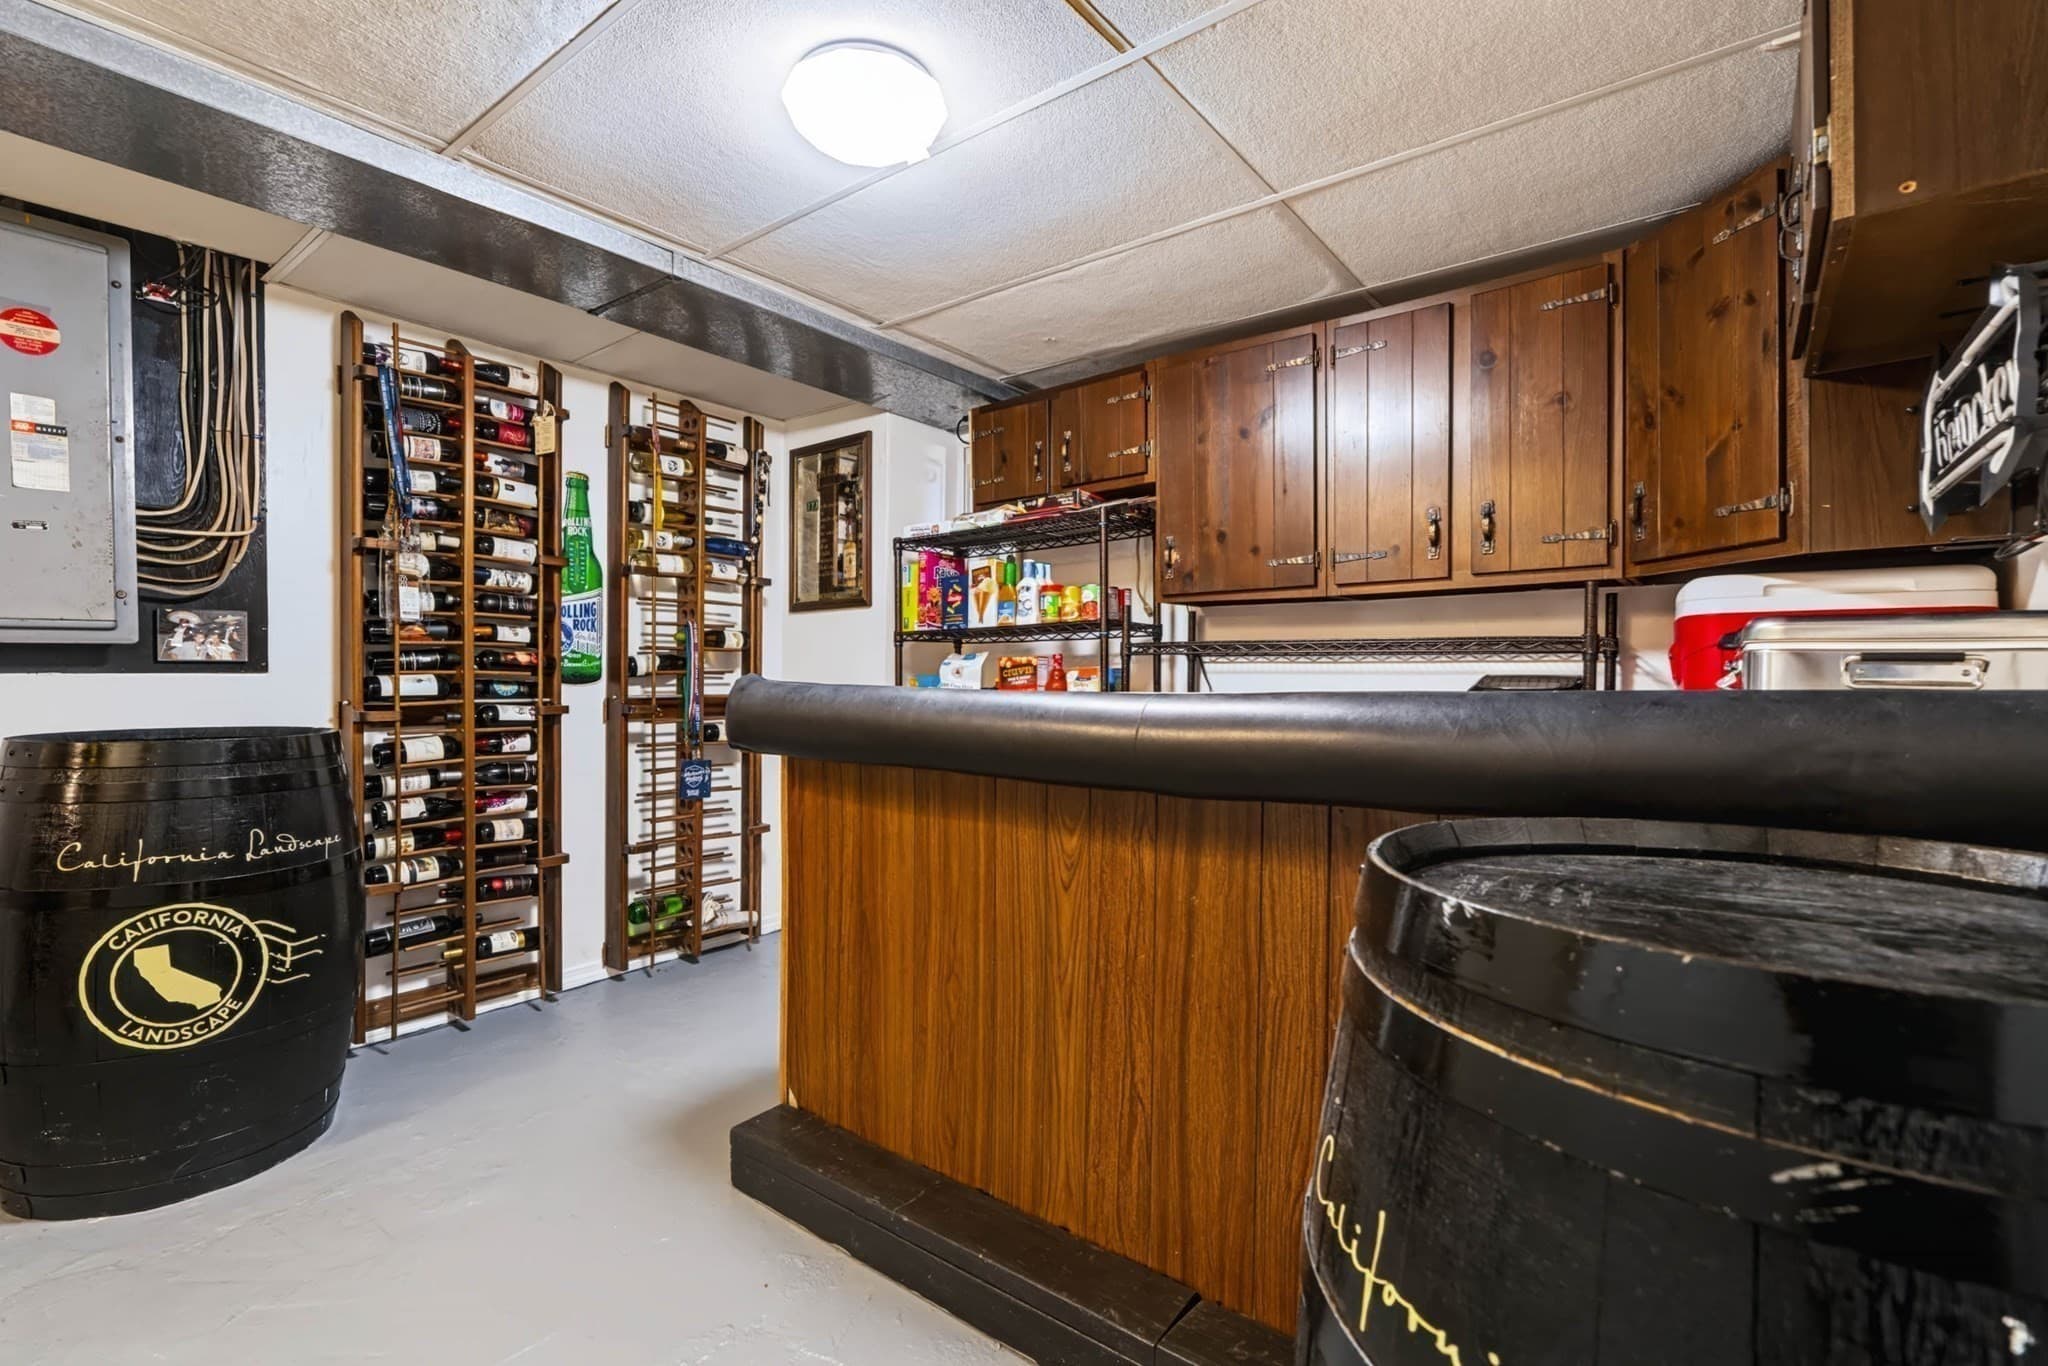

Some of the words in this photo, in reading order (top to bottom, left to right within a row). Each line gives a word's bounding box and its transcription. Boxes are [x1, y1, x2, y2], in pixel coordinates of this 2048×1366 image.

[567, 526, 588, 537] ROCK
[561, 602, 597, 618] OLLING
[573, 618, 597, 633] ROCK
[57, 838, 235, 882] California
[245, 828, 342, 859] Landscape
[108, 909, 245, 953] CALIFORNIA
[118, 997, 244, 1044] LANDSCAPE
[1316, 1134, 1501, 1366] Californ
